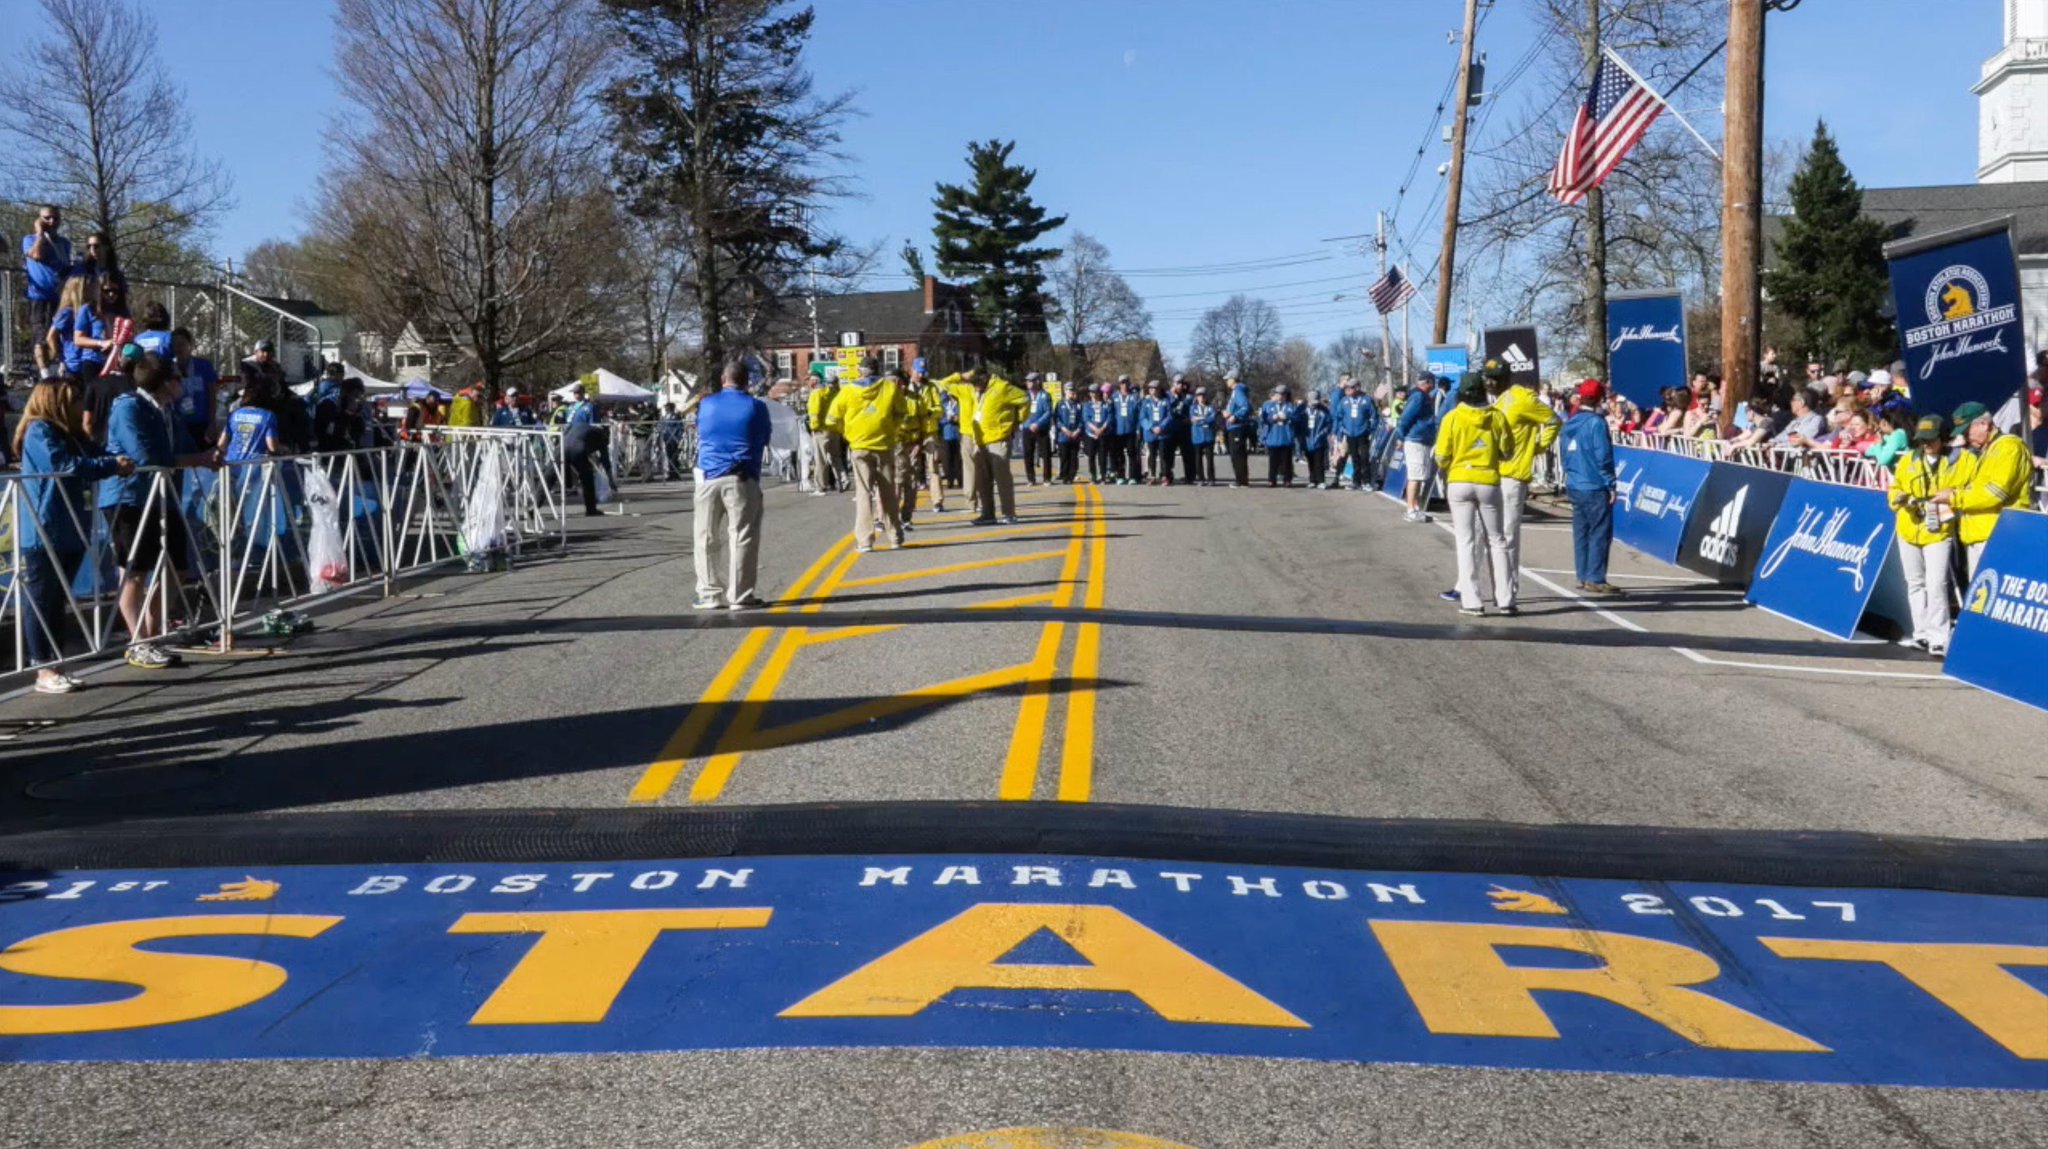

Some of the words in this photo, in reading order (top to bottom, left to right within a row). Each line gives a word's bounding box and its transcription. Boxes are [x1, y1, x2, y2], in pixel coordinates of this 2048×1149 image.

[1906, 324, 1951, 345] BOSTON
[1953, 308, 2014, 333] MARATHON
[1920, 343, 1956, 380] John
[1954, 328, 2008, 357] Hancock
[1700, 533, 1738, 568] adidas
[1760, 503, 1823, 579] John
[1814, 506, 1884, 592] Hancock
[2000, 574, 2027, 598] THE
[347, 868, 754, 895] BOSTON
[858, 866, 1427, 903] MARATHON
[1620, 893, 1856, 921] 2017
